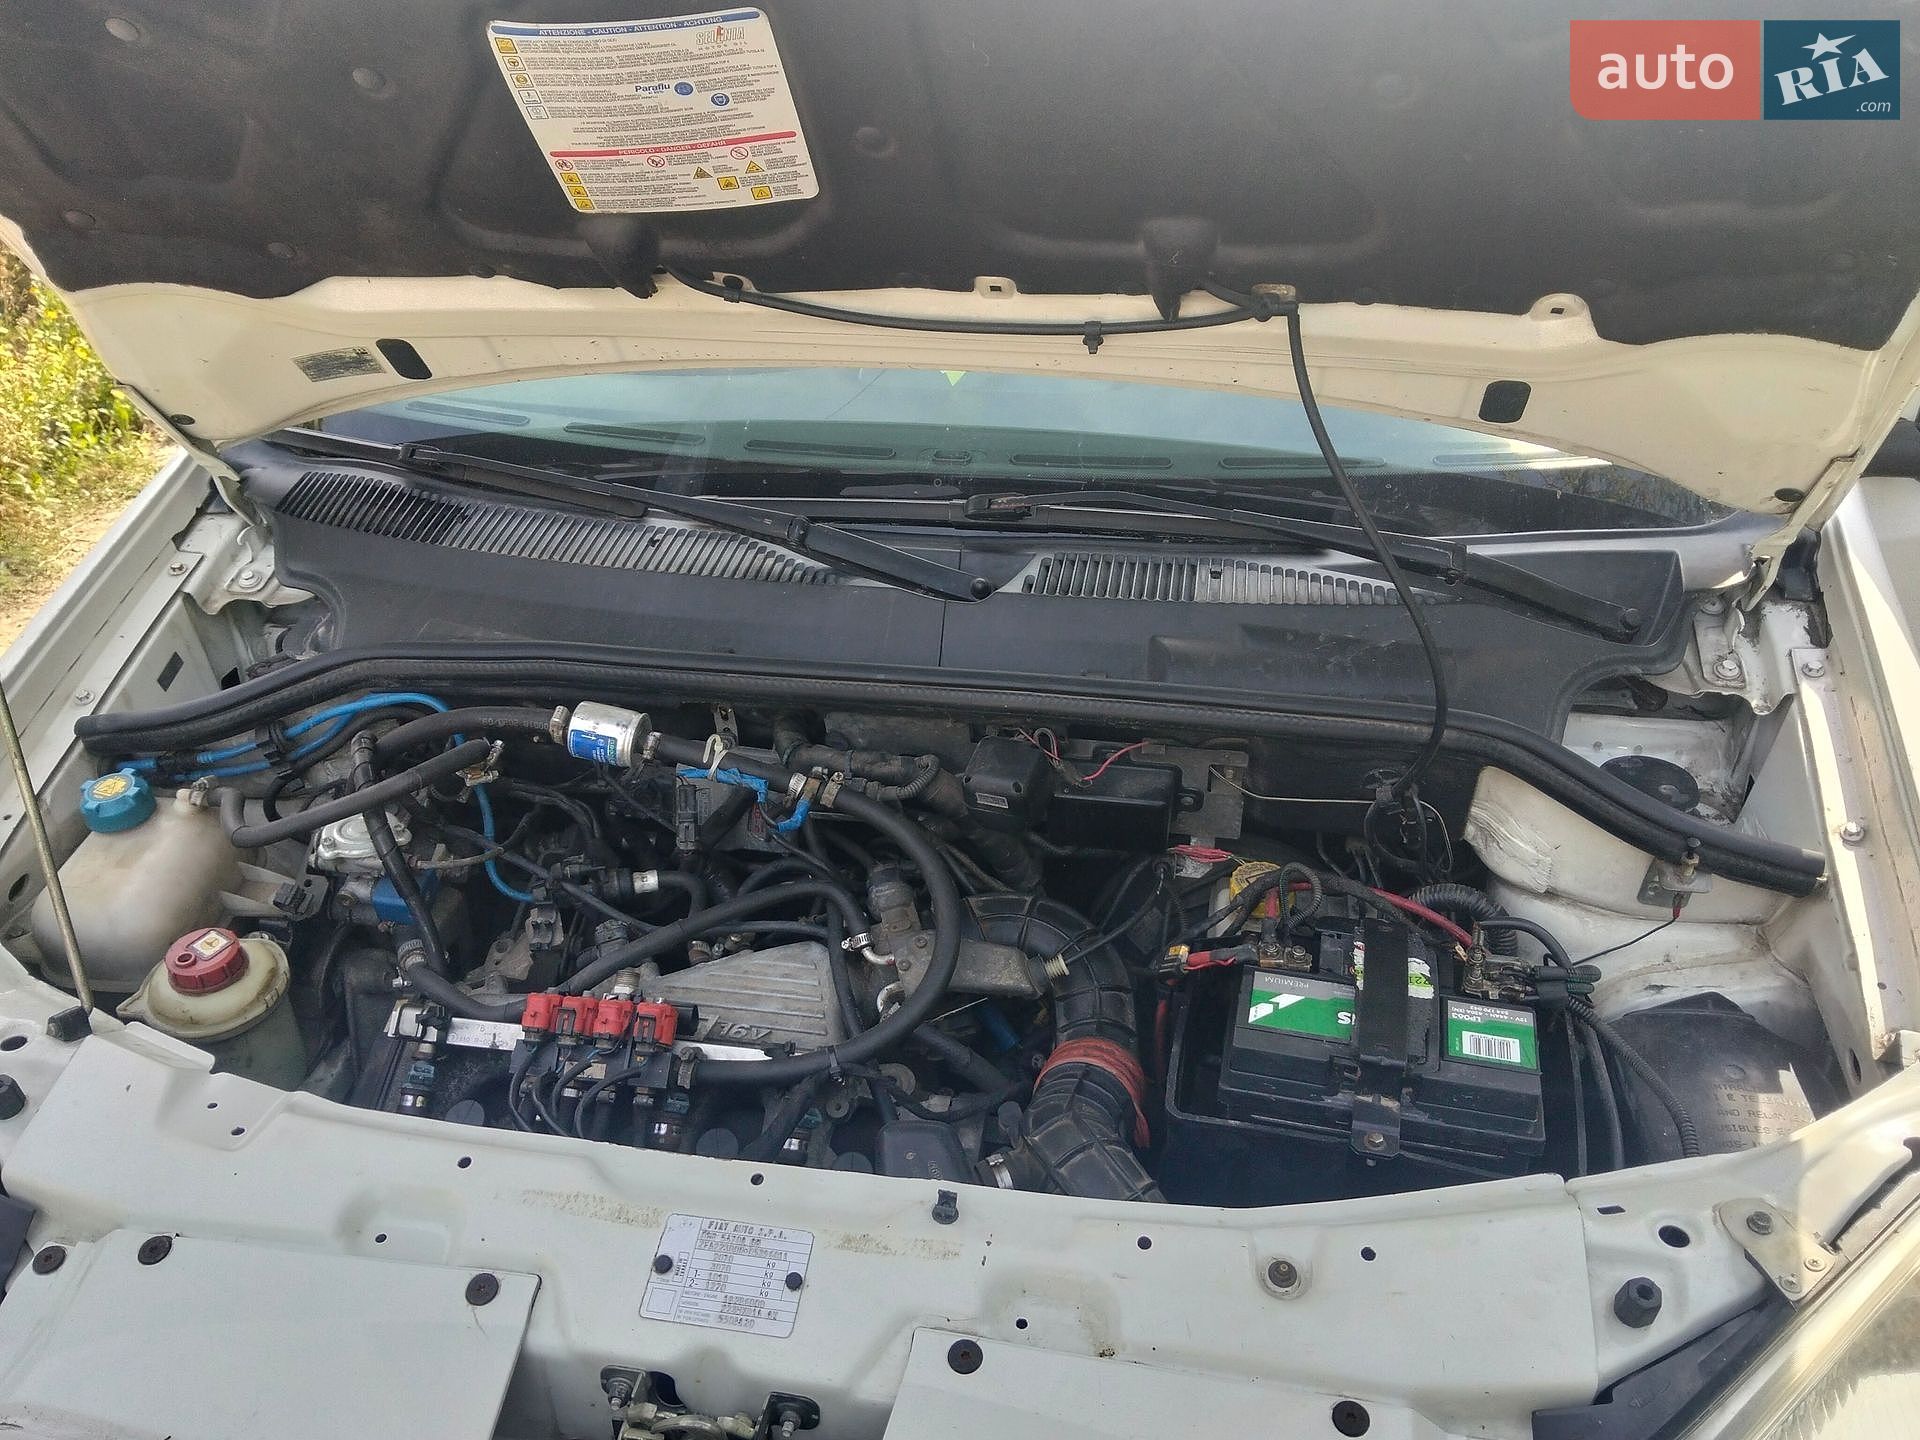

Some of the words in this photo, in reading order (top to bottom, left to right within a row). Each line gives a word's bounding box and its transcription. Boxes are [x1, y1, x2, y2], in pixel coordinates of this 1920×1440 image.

[593, 26, 627, 35] CAUTION
[634, 22, 677, 32] ATTENTION
[683, 16, 723, 27] ACHTUNG
[634, 83, 671, 93] Paraflu
[660, 144, 693, 152] DANGER
[697, 140, 727, 149] GEFAHR
[1264, 976, 1309, 989] PREMIUM
[707, 1220, 729, 1231] FIAT
[733, 1224, 754, 1235] AUTO
[766, 1260, 776, 1269] kg
[764, 1270, 774, 1279] kg
[759, 1289, 769, 1298] kg
